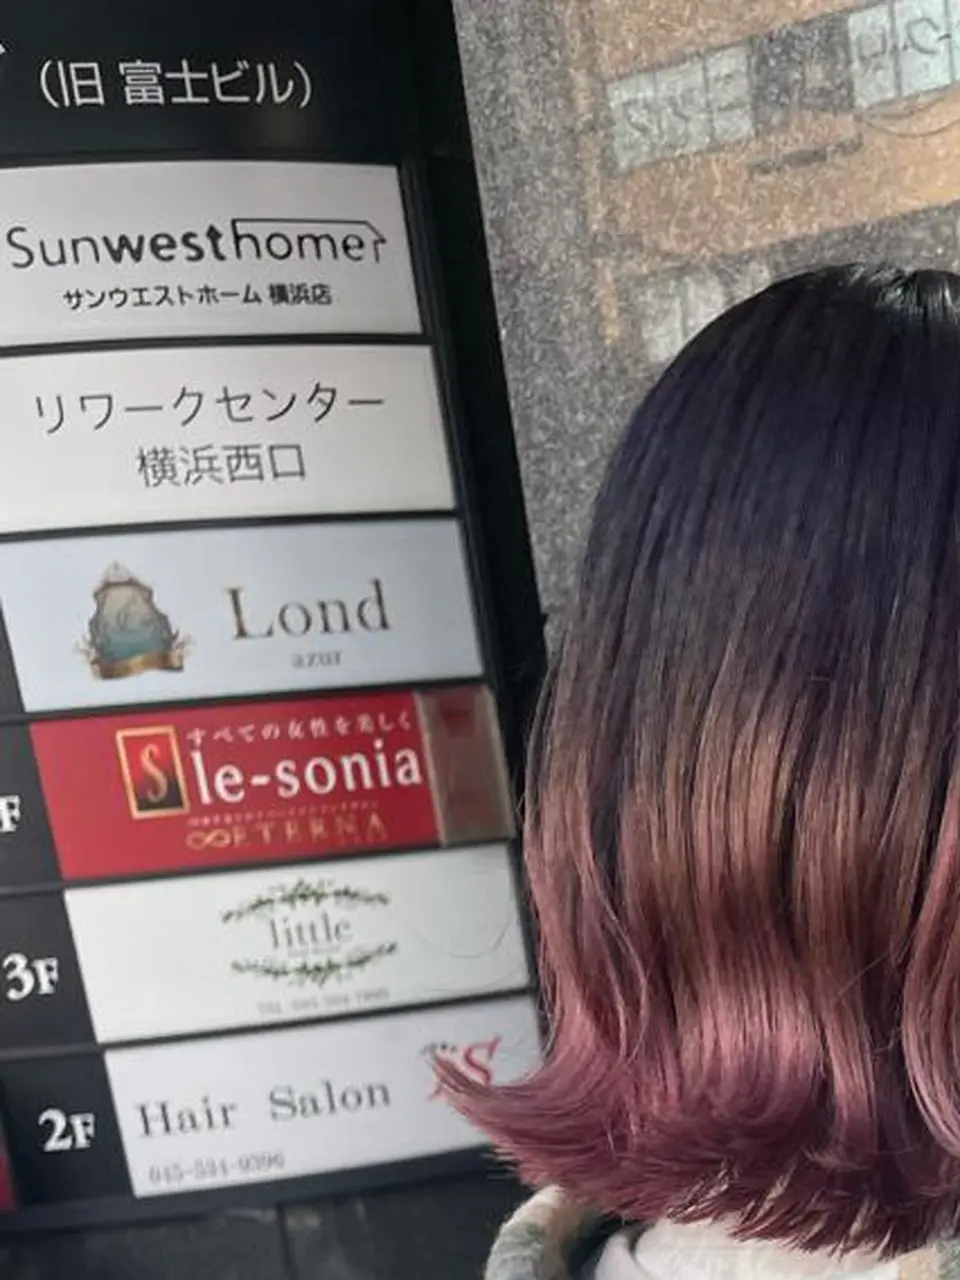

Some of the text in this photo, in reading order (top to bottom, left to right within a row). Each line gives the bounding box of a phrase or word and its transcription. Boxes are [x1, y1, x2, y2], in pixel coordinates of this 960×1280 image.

[63, 283, 333, 310] サンウエストホーム 横浜店
[35, 382, 386, 434] リワークセンター
[136, 443, 306, 488] 横浜西口
[225, 578, 391, 641] Lond
[190, 738, 422, 805] le-sonia
[269, 909, 353, 949] little
[2, 952, 59, 1001] 3F
[38, 1108, 96, 1152] 2F
[135, 1080, 391, 1138] Hair Salon
